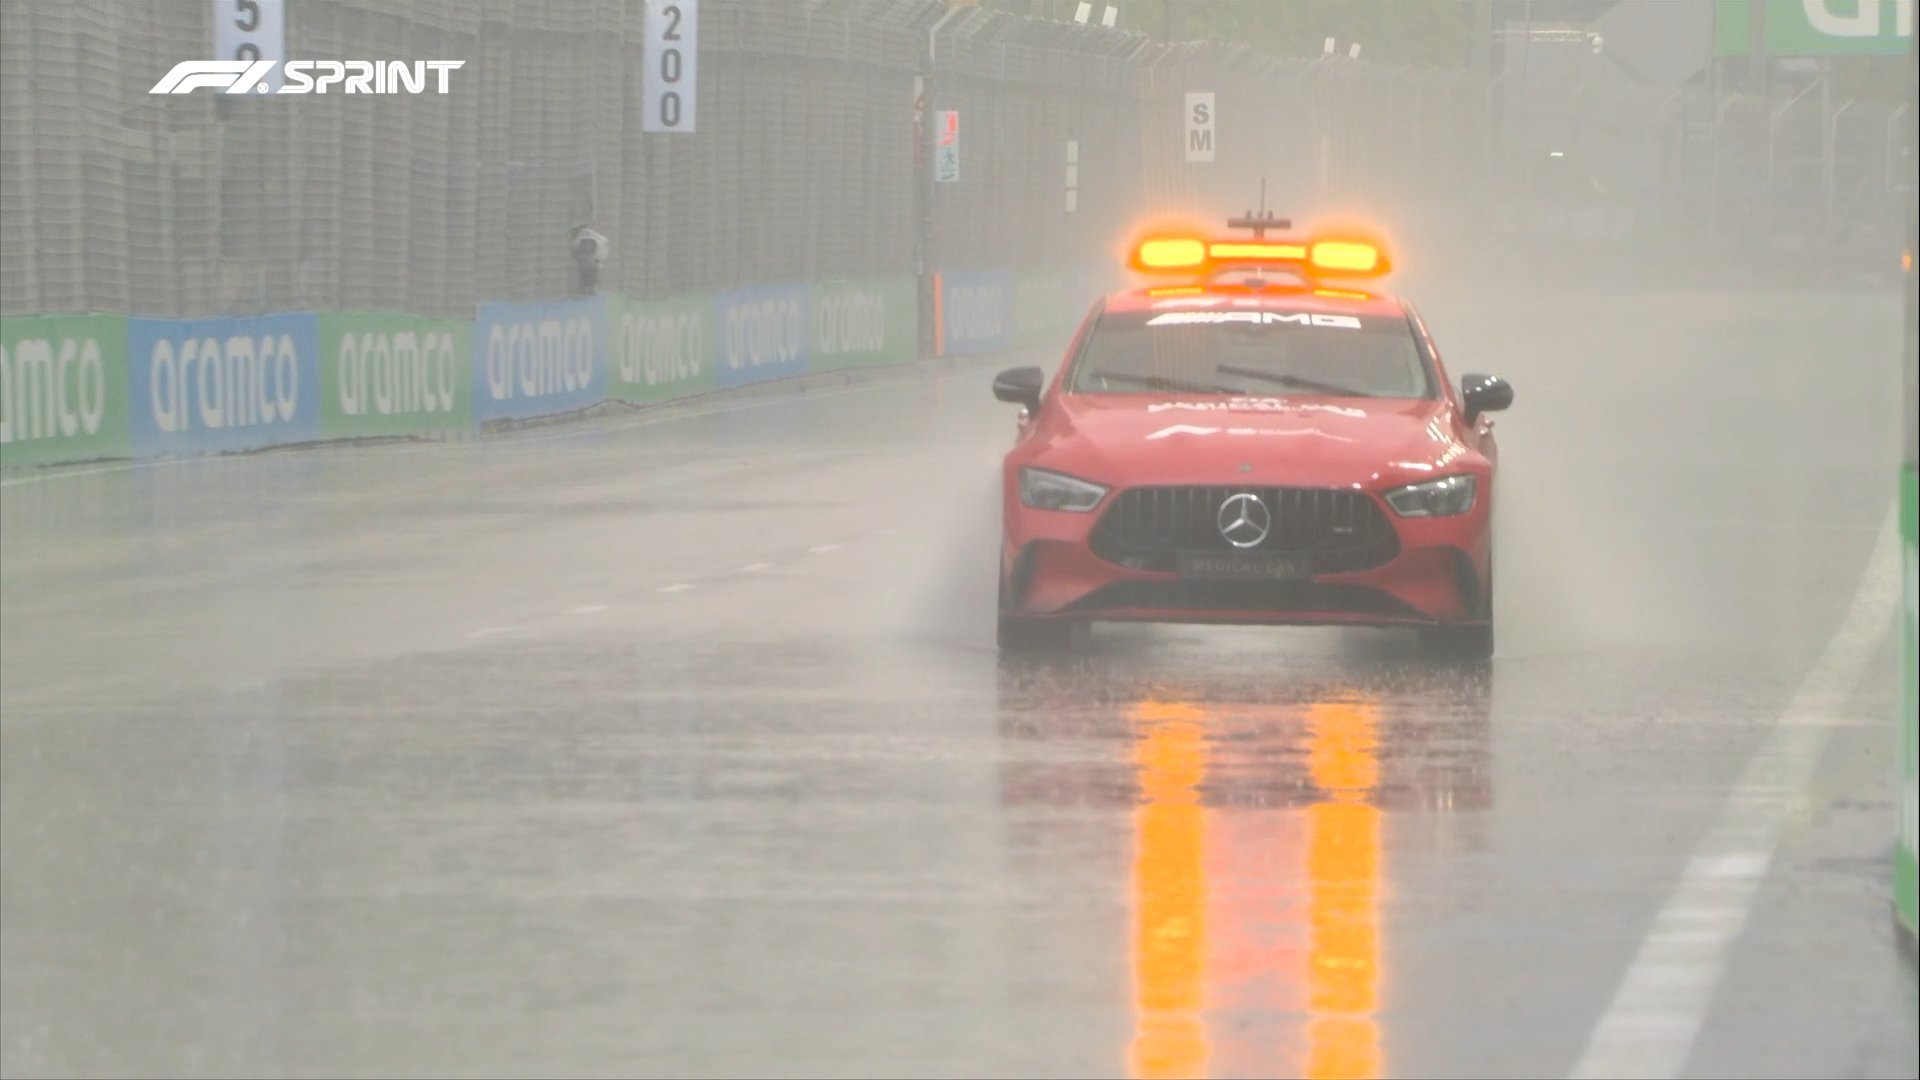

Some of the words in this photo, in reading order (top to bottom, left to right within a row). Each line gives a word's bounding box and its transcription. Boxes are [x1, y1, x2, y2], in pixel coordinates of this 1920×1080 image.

[661, 5, 681, 127] 200
[337, 331, 456, 415] aramco
[488, 319, 593, 400] aramco
[619, 311, 702, 386] aramco
[726, 297, 800, 369] aramco
[152, 334, 298, 432] aramco
